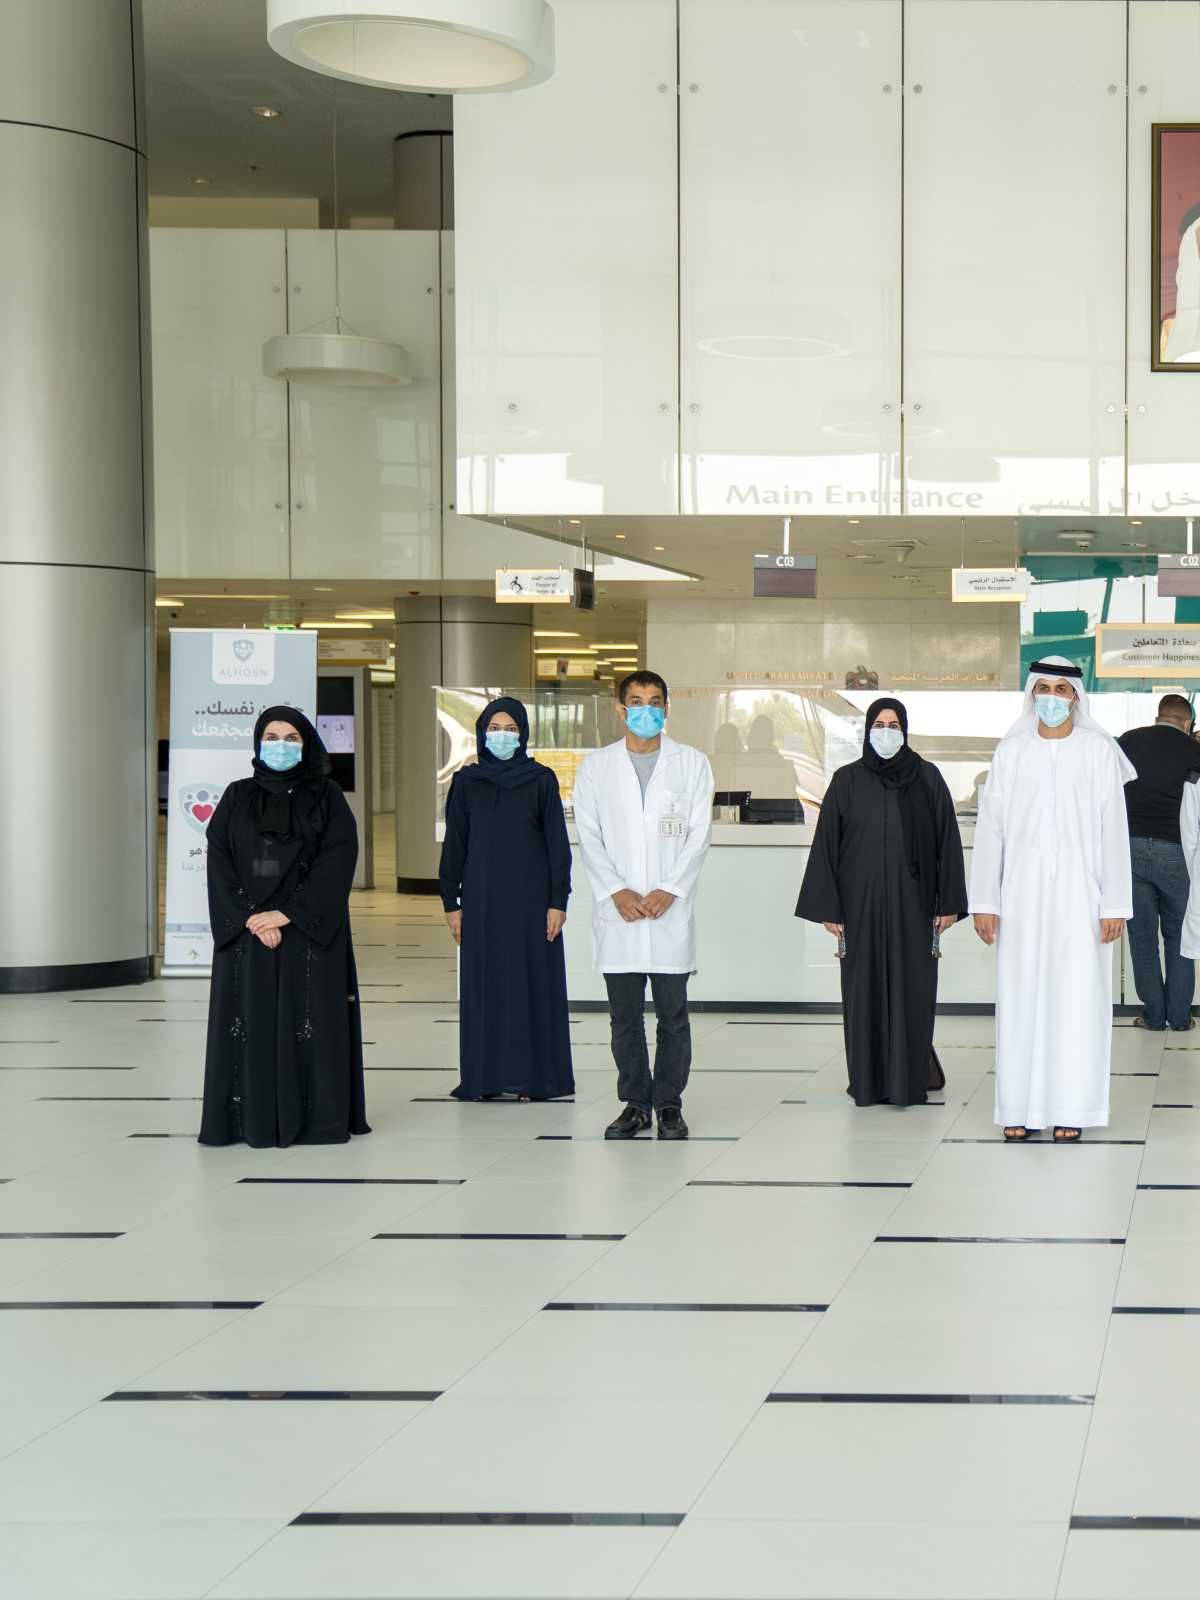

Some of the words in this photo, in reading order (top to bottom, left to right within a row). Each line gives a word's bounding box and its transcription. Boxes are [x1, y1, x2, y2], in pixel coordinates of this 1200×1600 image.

[725, 484, 813, 505] Main
[775, 556, 795, 567] C03
[1179, 555, 1200, 567] C02
[1122, 653, 1160, 661] Customer
[219, 668, 268, 677] ALHOSN
